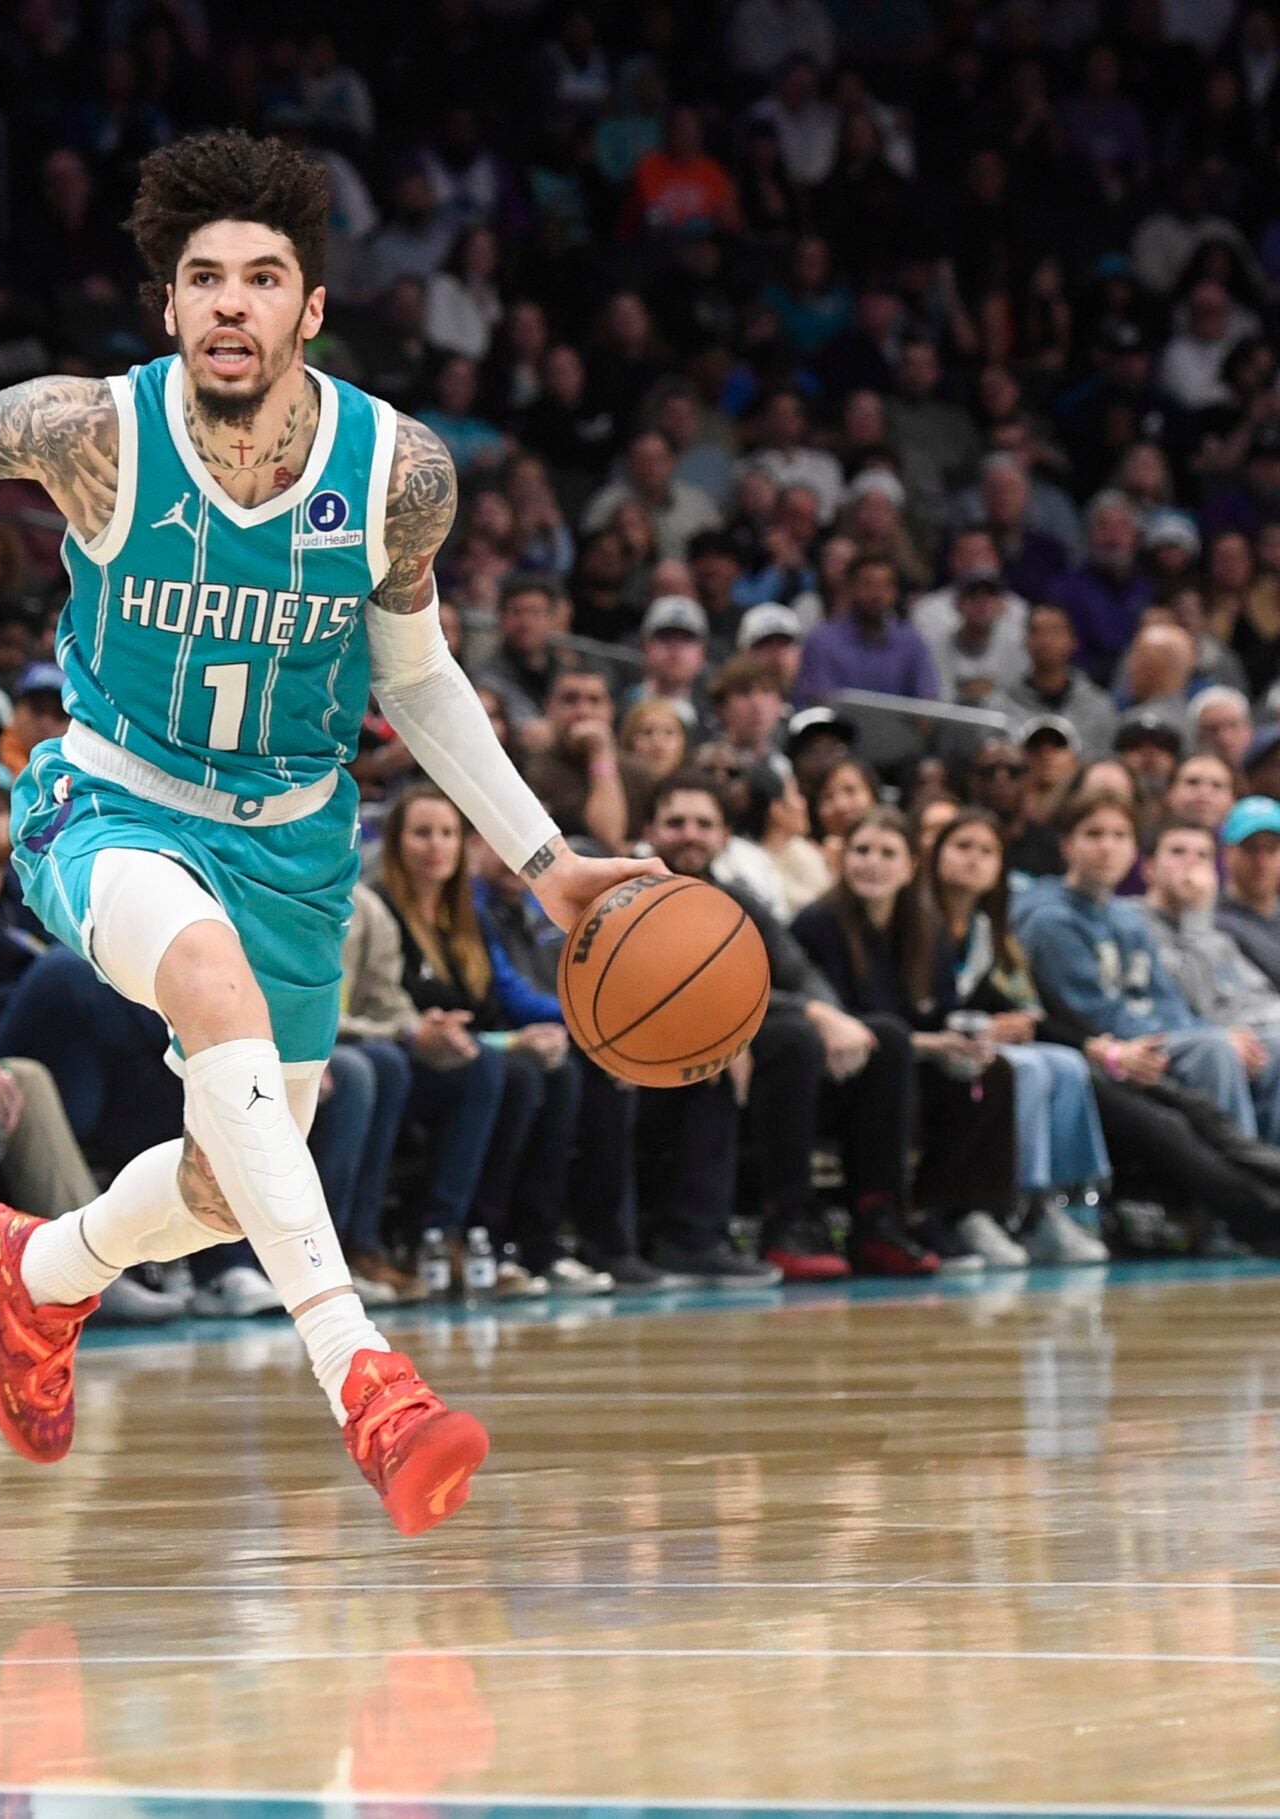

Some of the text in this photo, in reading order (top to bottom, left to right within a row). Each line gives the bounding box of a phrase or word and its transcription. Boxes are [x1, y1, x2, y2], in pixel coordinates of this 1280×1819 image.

[294, 532, 361, 546] Judi Health
[118, 575, 359, 646] HORNETS
[203, 662, 250, 751] 1
